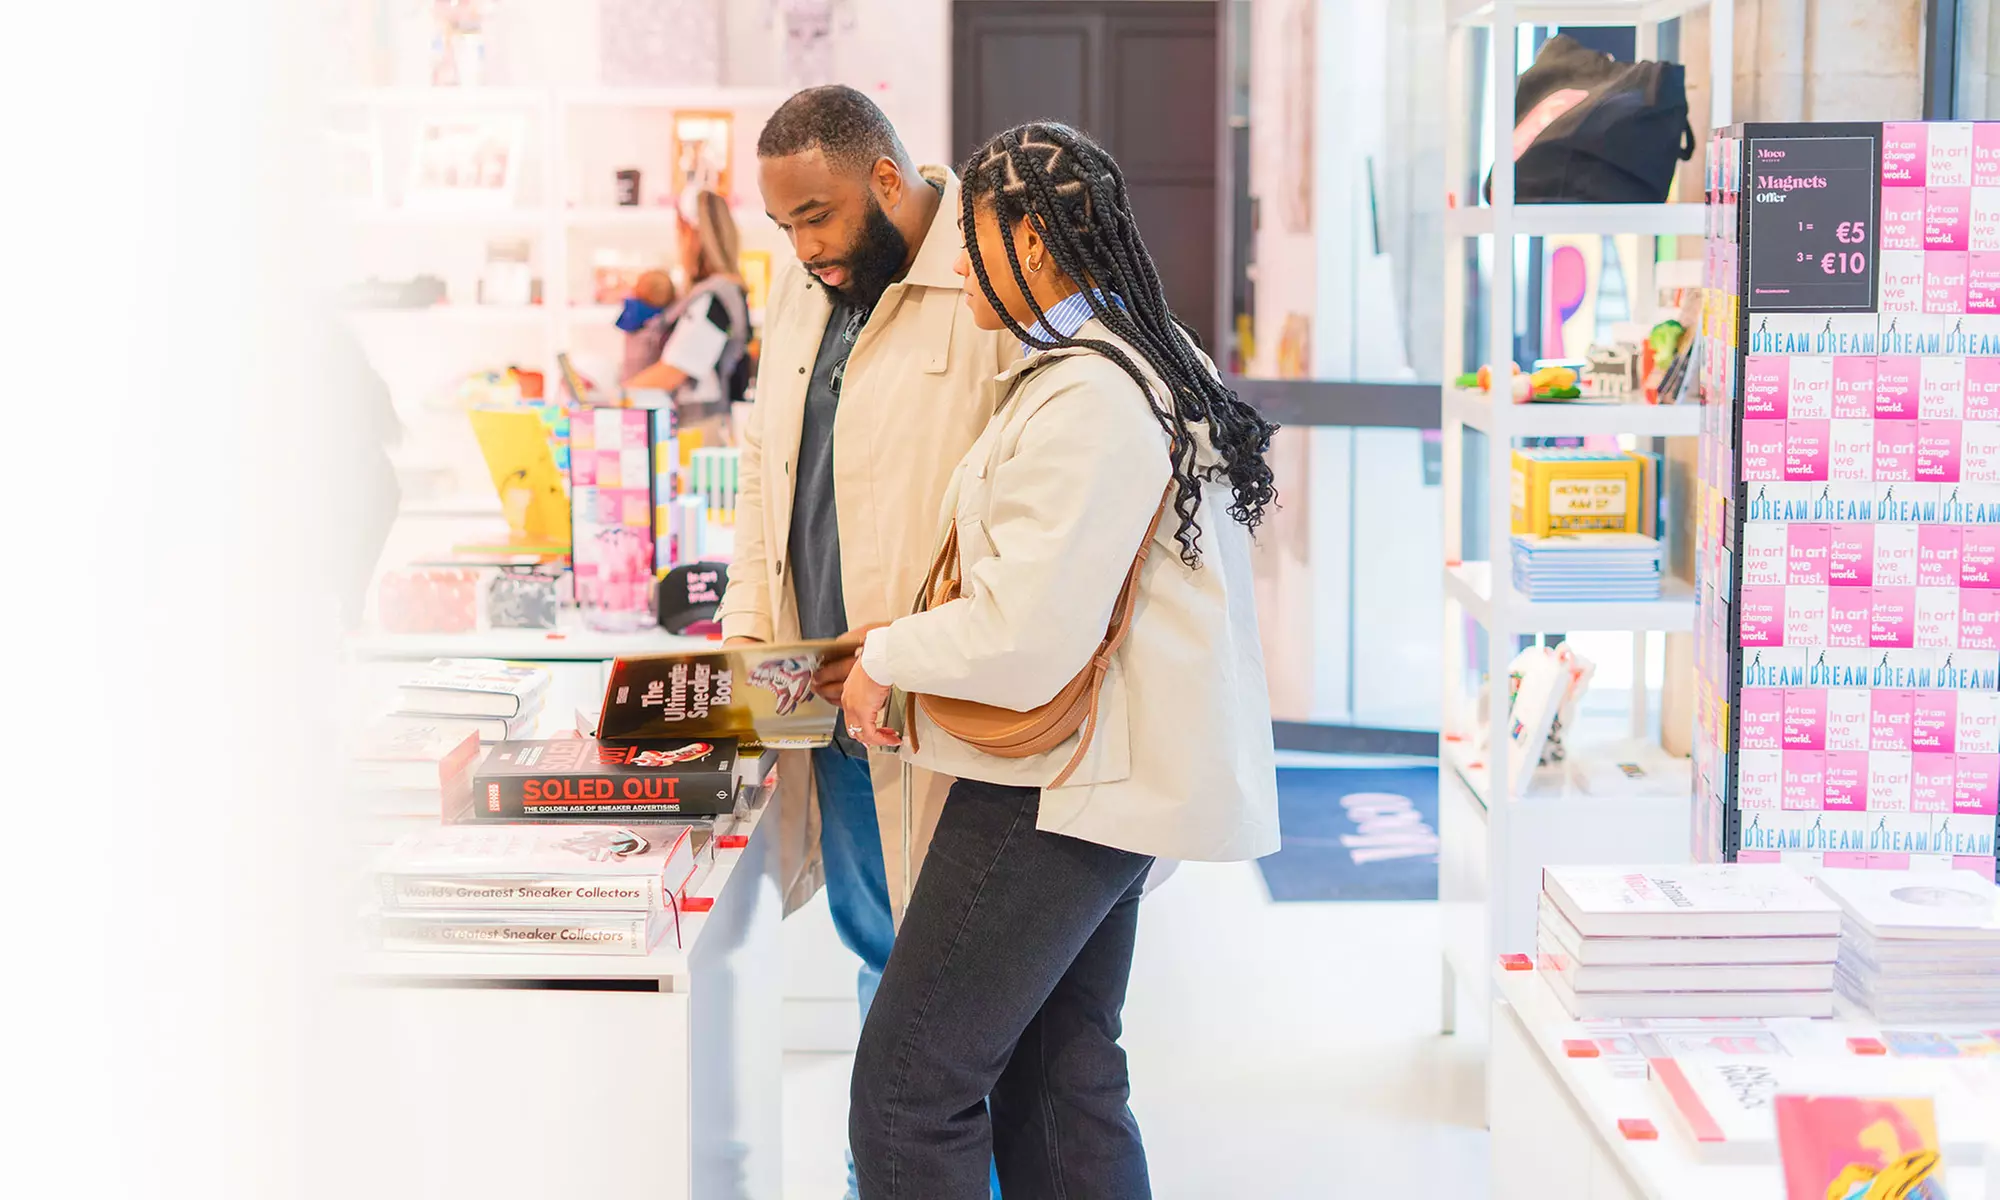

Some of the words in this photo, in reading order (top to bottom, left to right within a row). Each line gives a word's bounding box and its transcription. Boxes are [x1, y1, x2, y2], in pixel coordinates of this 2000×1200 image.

[1758, 150, 1785, 158] Moco
[1884, 151, 1915, 161] change
[1884, 161, 1897, 170] the
[1884, 170, 1911, 179] world.
[1757, 175, 1828, 192] Magnets
[1756, 192, 1787, 202] Offer
[1886, 208, 1897, 221] In
[1901, 209, 1923, 221] art
[1836, 221, 1865, 243] €5
[1884, 225, 1905, 234] we
[1884, 236, 1919, 248] trust.
[1821, 252, 1865, 274] €10
[1885, 272, 1896, 284] In
[1901, 274, 1921, 284] art
[1884, 289, 1904, 298] we
[1884, 300, 1918, 311] trust.
[1753, 333, 1810, 352] DREAM
[1817, 333, 1874, 353] DREAM
[1882, 333, 1939, 353] DREAM
[1946, 334, 2000, 354] DREAM
[1747, 383, 1778, 394] change
[1794, 378, 1805, 390] In
[1809, 380, 1829, 390] art
[1837, 378, 1848, 391] In
[1852, 379, 1874, 391] art
[1748, 394, 1760, 403] the
[1793, 395, 1813, 404] we
[1835, 395, 1856, 404] we
[1747, 402, 1774, 411] world.
[1792, 406, 1827, 417] trust.
[1835, 406, 1870, 417] trust.
[1834, 440, 1846, 452] In
[1850, 442, 1870, 453] art
[1878, 440, 1889, 454] In
[1893, 442, 1915, 454] art
[1918, 447, 1949, 457] change
[1834, 457, 1854, 466] we
[1876, 458, 1897, 467] we
[1918, 457, 1931, 466] the
[1833, 468, 1868, 479] trust.
[1876, 468, 1911, 480] trust.
[1918, 465, 1945, 474] world.
[1751, 500, 1807, 520] DREAM
[1814, 500, 1871, 520] DREAM
[1878, 500, 1935, 521] DREAM
[1944, 502, 2000, 522] DREAM
[1878, 546, 1890, 558] In
[1894, 548, 1914, 558] art
[1922, 546, 1933, 559] In
[1937, 547, 1959, 559] art
[1963, 554, 1993, 564] change
[1878, 563, 1898, 571] we
[1920, 563, 1941, 572] we
[1963, 564, 1976, 573] the
[1877, 573, 1911, 584] trust.
[1920, 574, 1955, 585] trust.
[1962, 572, 1990, 581] world.
[1742, 613, 1772, 623] change
[1788, 606, 1800, 618] In
[1804, 608, 1824, 619] art
[1832, 606, 1843, 620] In
[1847, 608, 1869, 620] art
[1742, 623, 1755, 632] the
[1788, 623, 1808, 632] we
[1831, 623, 1852, 633] we
[1742, 631, 1768, 640] world.
[1788, 634, 1822, 645] trust.
[1831, 634, 1866, 646] trust.
[1746, 666, 1803, 685] DREAM
[1811, 666, 1867, 685] DREAM
[1874, 667, 1930, 688] DREAM
[1937, 668, 1994, 689] DREAM
[664, 664, 688, 722] Ultimate
[687, 663, 710, 718] Sneaker
[710, 670, 732, 705] Book
[641, 680, 664, 707] The
[1874, 710, 1885, 723] In
[1889, 711, 1911, 724] art
[1915, 708, 1928, 716] Art
[1914, 718, 1945, 728] change
[1961, 712, 1972, 724] In
[1976, 715, 1997, 725] art
[1872, 727, 1893, 736] we
[1914, 728, 1927, 737] the
[1960, 729, 1980, 738] we
[1872, 738, 1908, 749] trust.
[1914, 736, 1940, 745] world.
[1960, 740, 1994, 751] trust.
[1742, 770, 1754, 782] In
[1757, 772, 1778, 783] art
[1786, 769, 1797, 783] In
[1801, 771, 1823, 783] art
[1826, 777, 1857, 788] change
[523, 778, 614, 800] SOLED
[622, 778, 680, 798] OUT
[1742, 787, 1762, 796] we
[1785, 786, 1806, 796] we
[1826, 787, 1839, 796] the
[1742, 797, 1776, 808] trust.
[1785, 796, 1820, 808] trust.
[1826, 795, 1853, 804] world.
[1745, 829, 1800, 848] DREAM
[1807, 829, 1863, 849] DREAM
[1871, 830, 1927, 851] DREAM
[1934, 832, 1990, 853] DREAM
[456, 888, 514, 898] Greatest
[518, 888, 572, 898] Sneaker
[576, 888, 640, 898] Collectors
[442, 928, 498, 939] Greatest
[503, 928, 556, 940] Sneaker
[560, 929, 623, 941] Collectors
